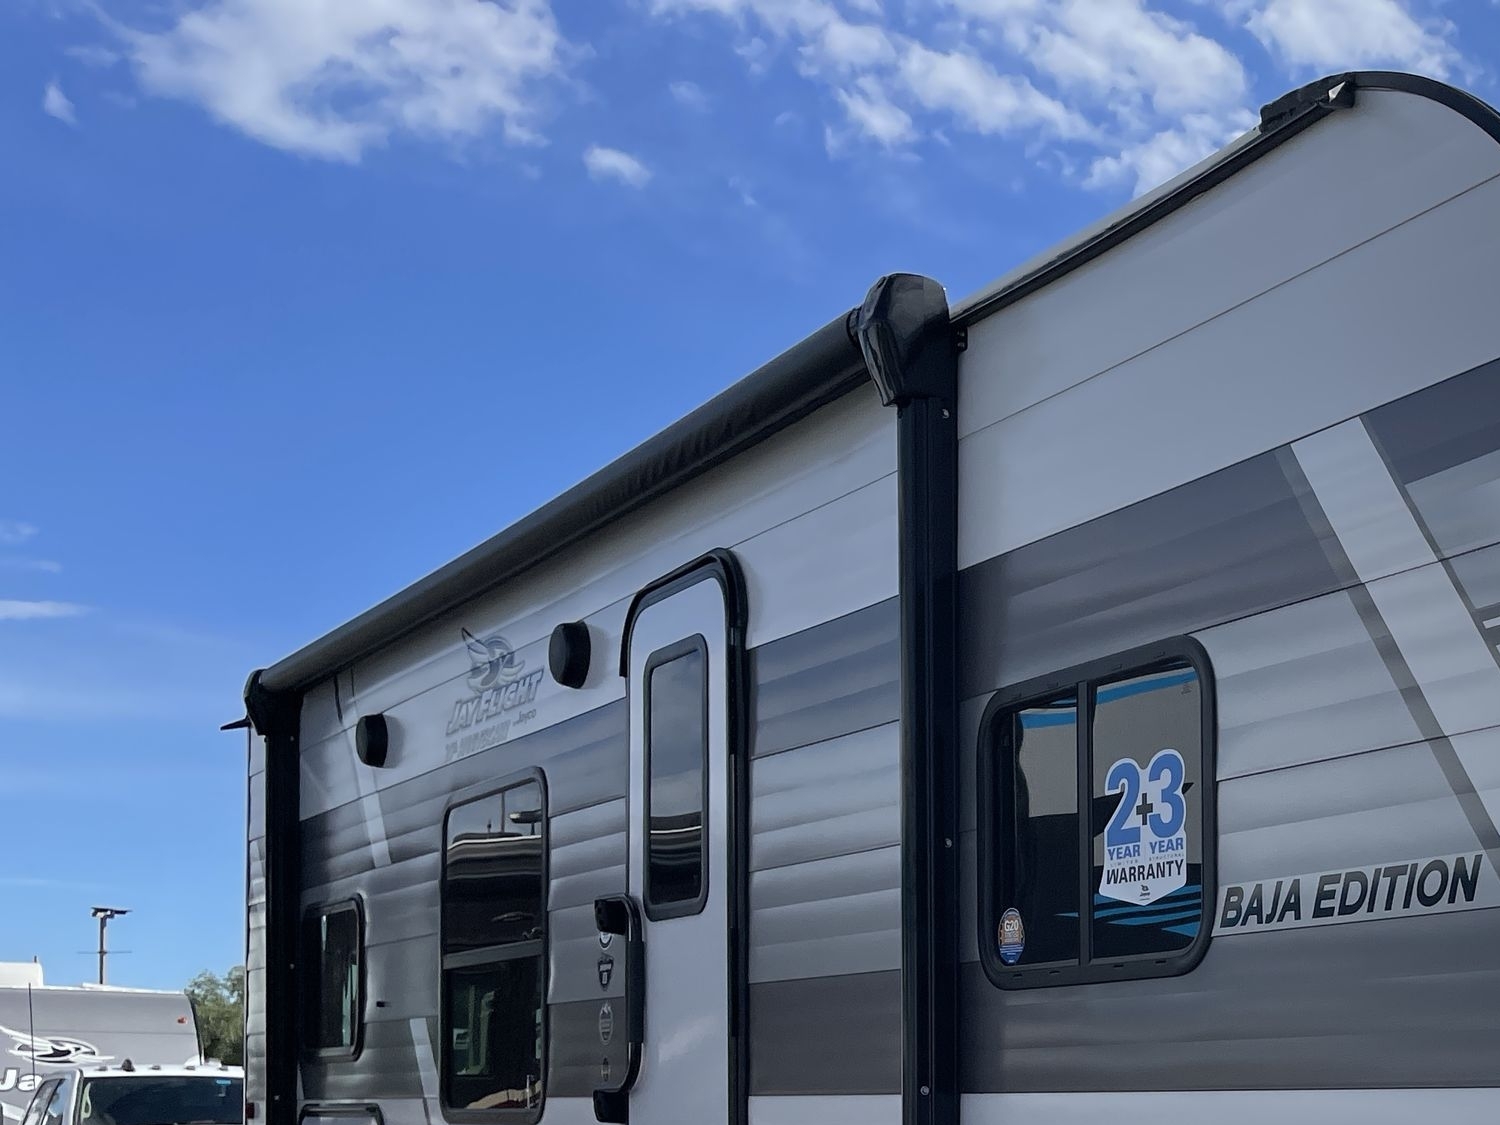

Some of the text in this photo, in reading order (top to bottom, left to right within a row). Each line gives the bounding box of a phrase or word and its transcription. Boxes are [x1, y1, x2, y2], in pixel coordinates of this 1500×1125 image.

[1108, 837, 1184, 860] YEAR YEAR
[1106, 859, 1184, 885] WARRANTY
[1219, 854, 1483, 928] BAJA EDITION
[1005, 919, 1019, 931] G20
